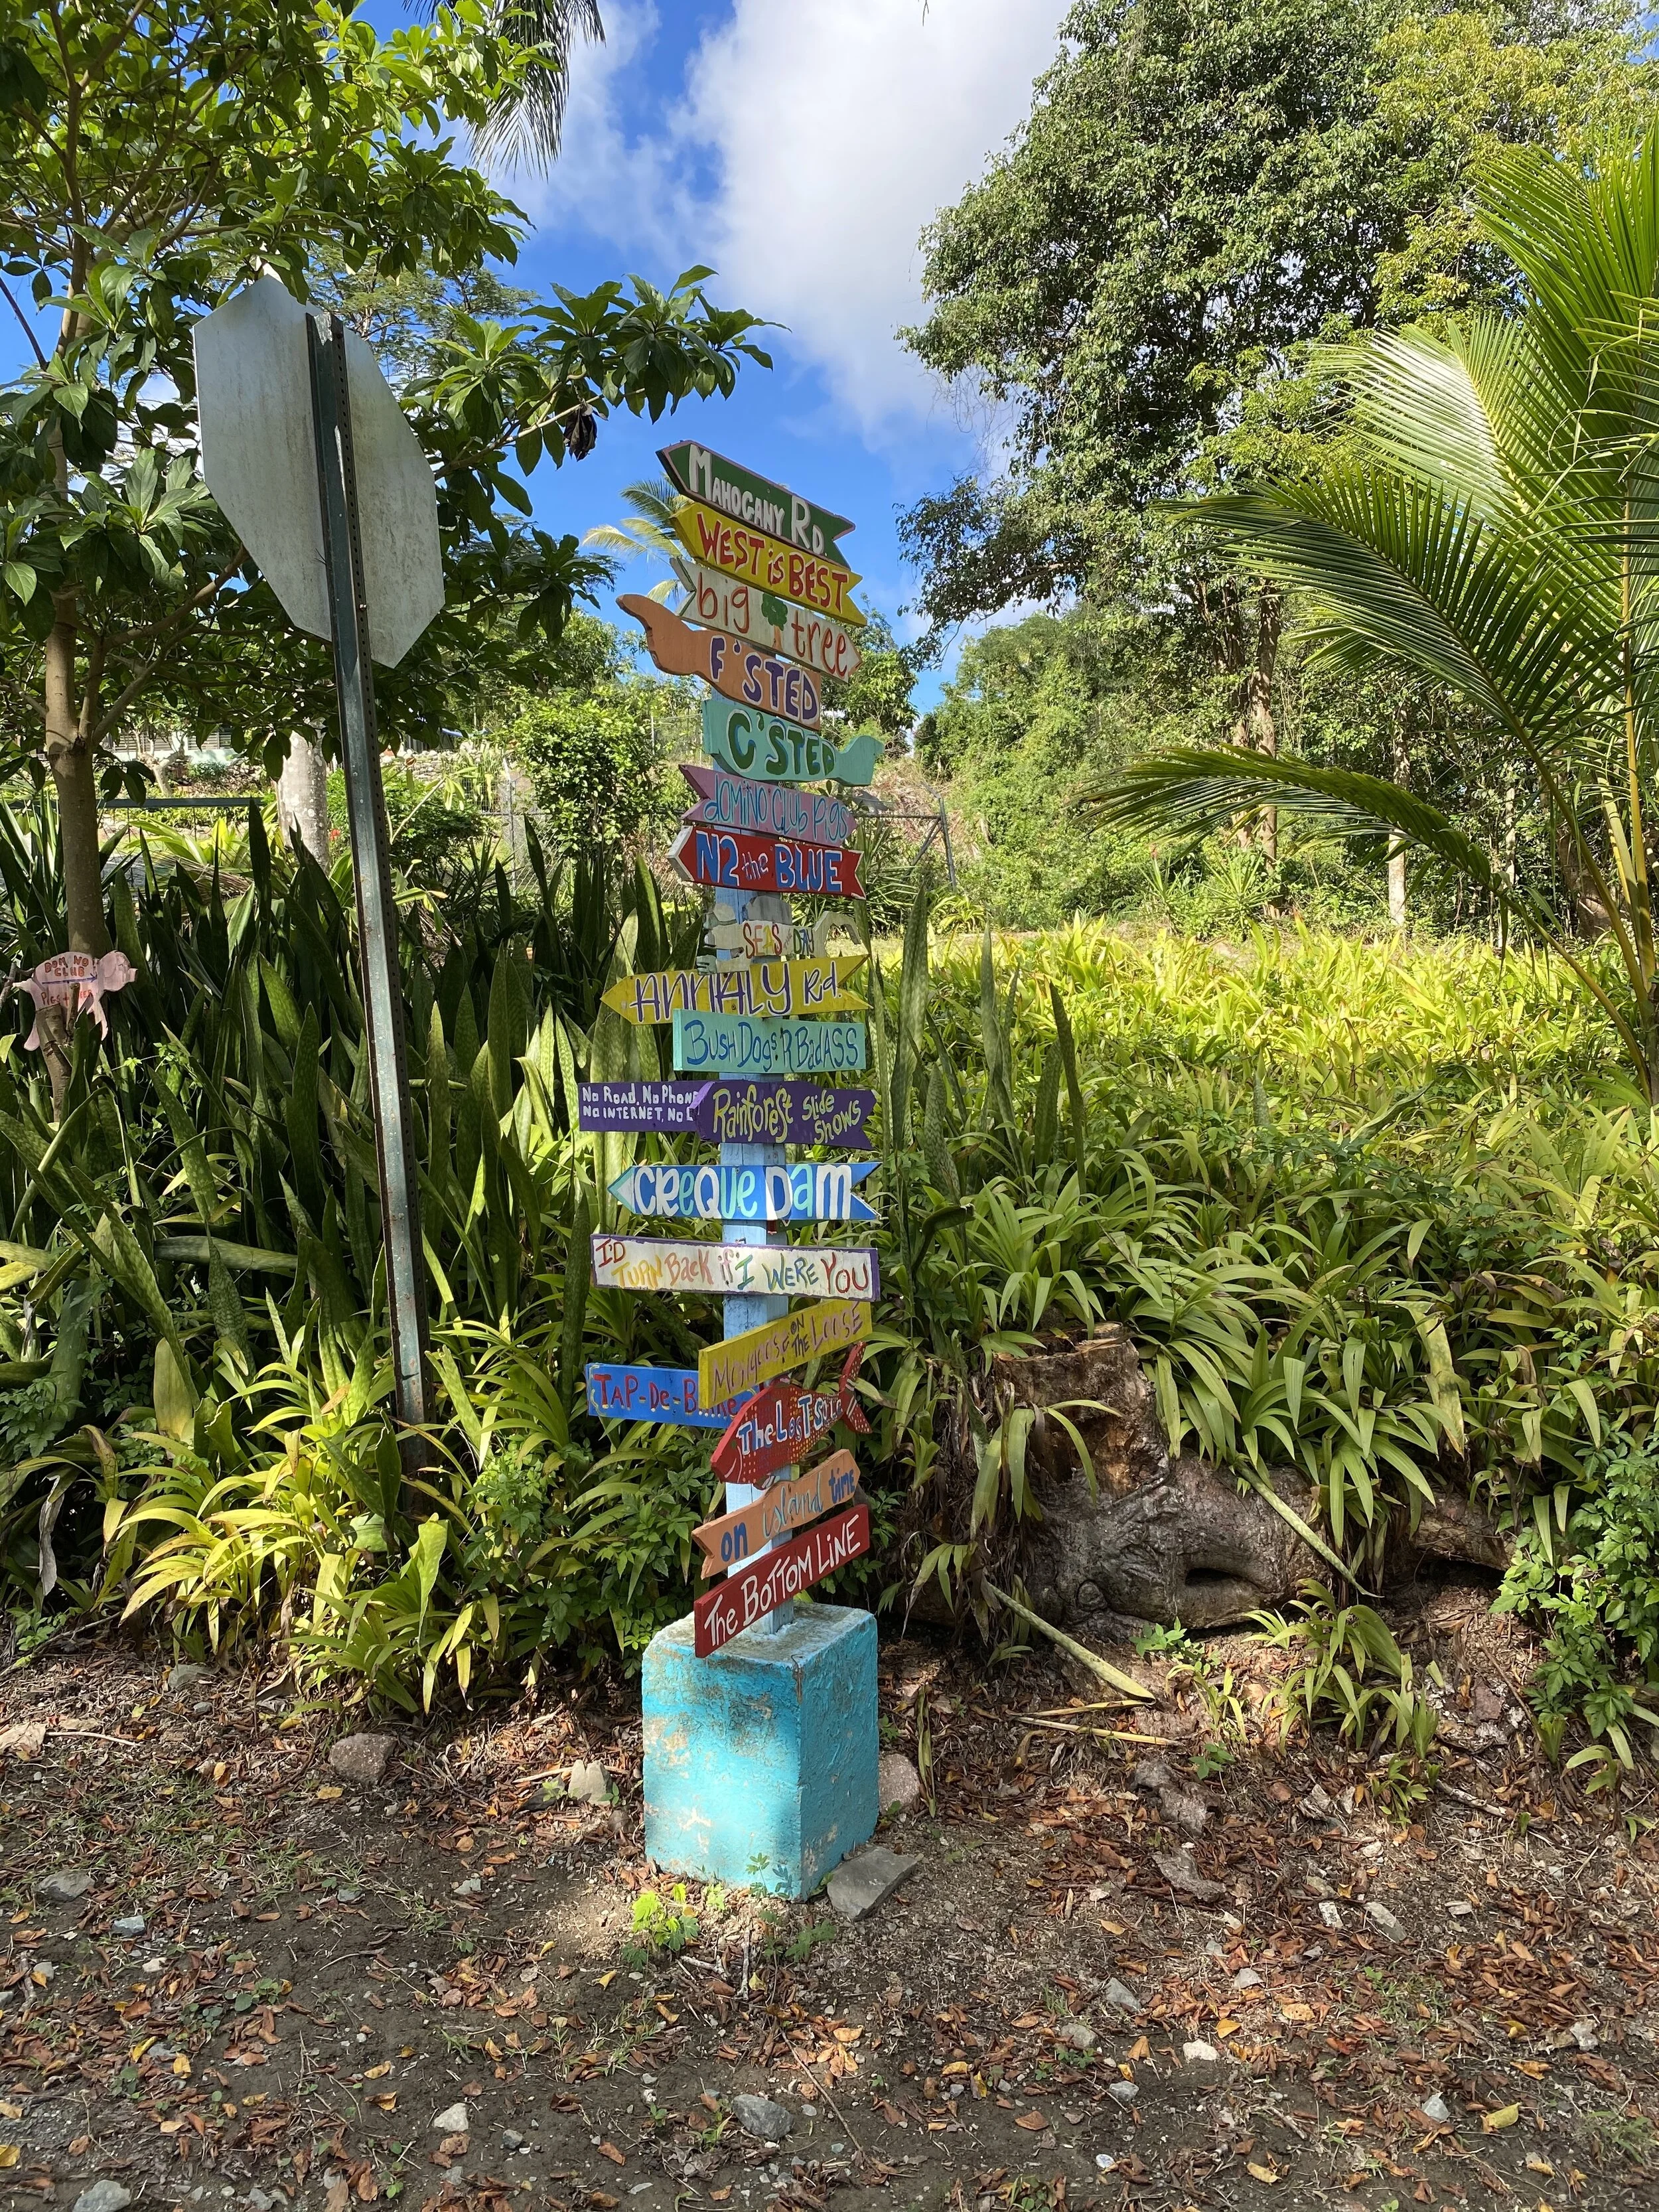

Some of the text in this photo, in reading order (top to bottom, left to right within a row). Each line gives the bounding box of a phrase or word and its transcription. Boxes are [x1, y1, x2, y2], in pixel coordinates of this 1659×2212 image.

[687, 444, 786, 536] MAHOGANY
[697, 512, 765, 575] WEST
[789, 552, 849, 613] BEST
[696, 572, 849, 677] big tree
[708, 635, 820, 725] F'STED
[727, 708, 836, 776] C'STED
[695, 830, 843, 892] N2 the BLUE
[54, 966, 85, 977] CLUB
[743, 922, 782, 959] SEAS
[793, 928, 815, 956] DAY
[713, 1084, 794, 1143] Rainforest
[802, 1089, 835, 1121] Slide
[595, 1240, 626, 1268] I'D
[611, 1254, 662, 1290] TURN
[735, 1254, 755, 1291] I
[761, 1252, 819, 1291] WERE
[820, 1251, 869, 1294] YOU
[790, 1313, 805, 1335] ON
[810, 1301, 863, 1351] LOOSE
[736, 1417, 774, 1455] The
[721, 1522, 749, 1563] on
[762, 1471, 824, 1540] island
[703, 1593, 739, 1647] The
[740, 1545, 814, 1627] BOTTOM
